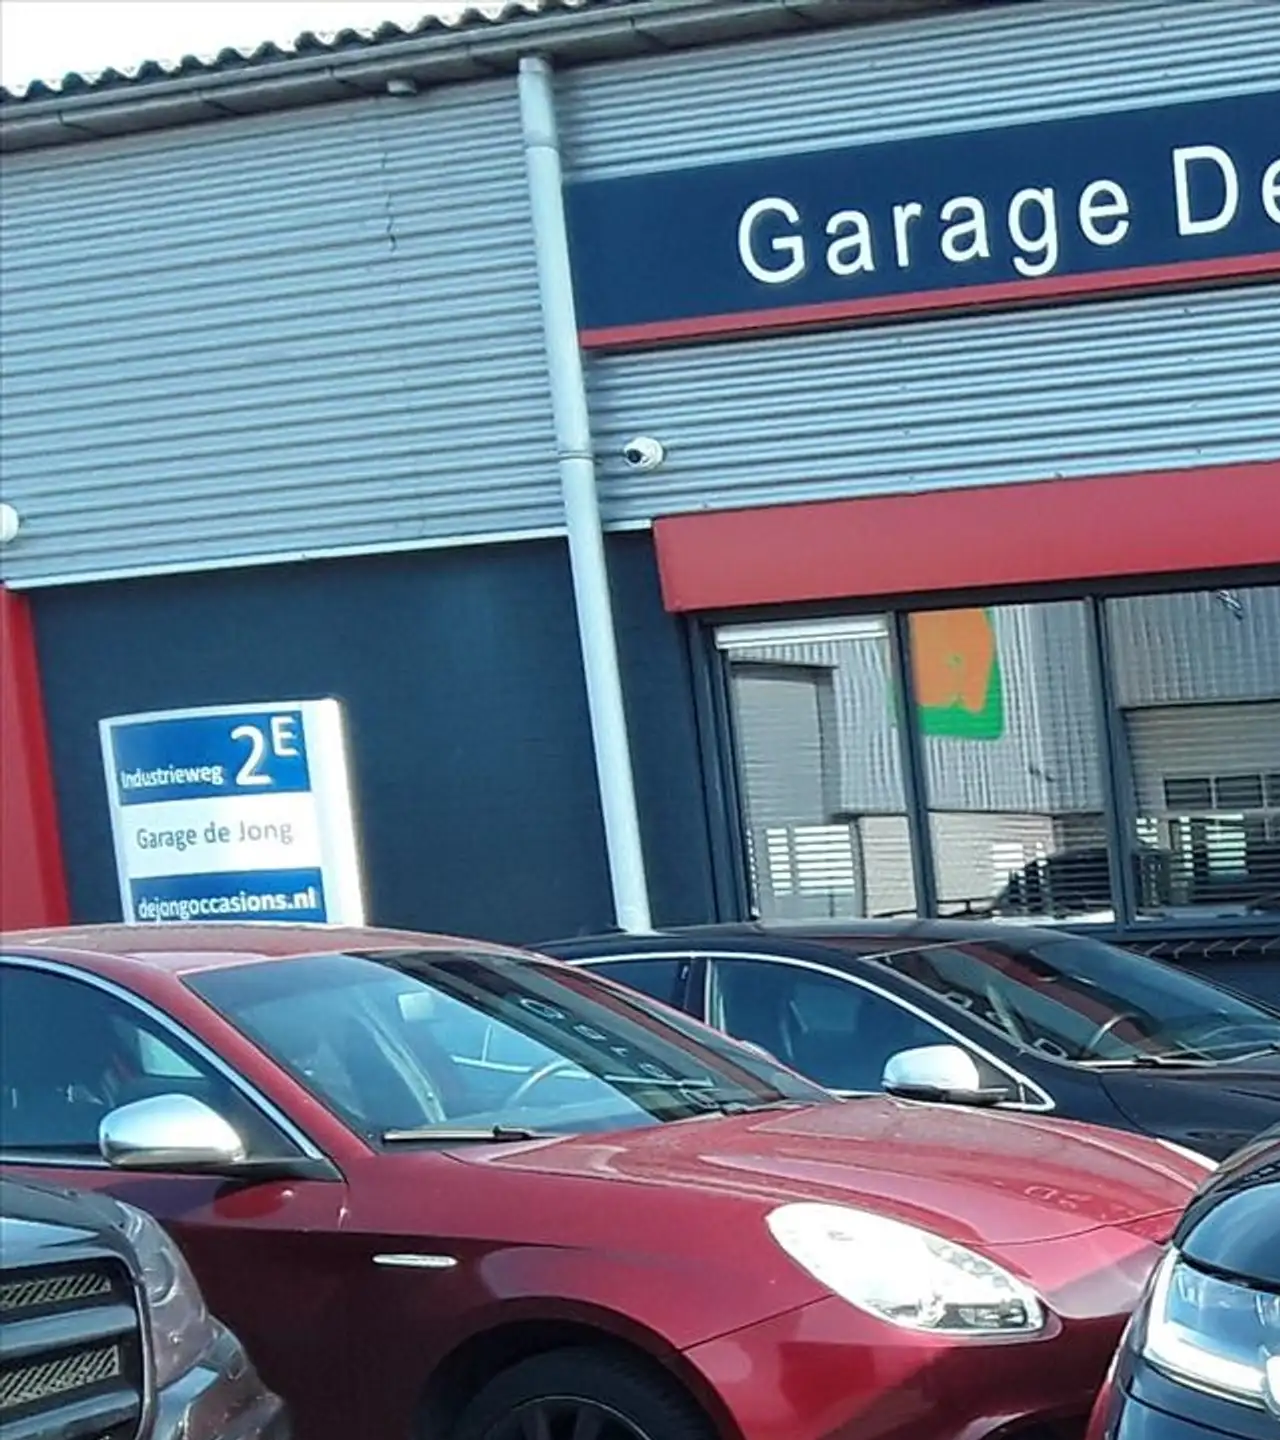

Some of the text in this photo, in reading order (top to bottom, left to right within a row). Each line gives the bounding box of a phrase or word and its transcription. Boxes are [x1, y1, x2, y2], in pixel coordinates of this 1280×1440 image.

[736, 178, 1131, 285] Garage
[120, 764, 224, 789] Industrieweg
[136, 820, 294, 851] Garage de Jong
[138, 886, 317, 922] dejongoccasions.nl
